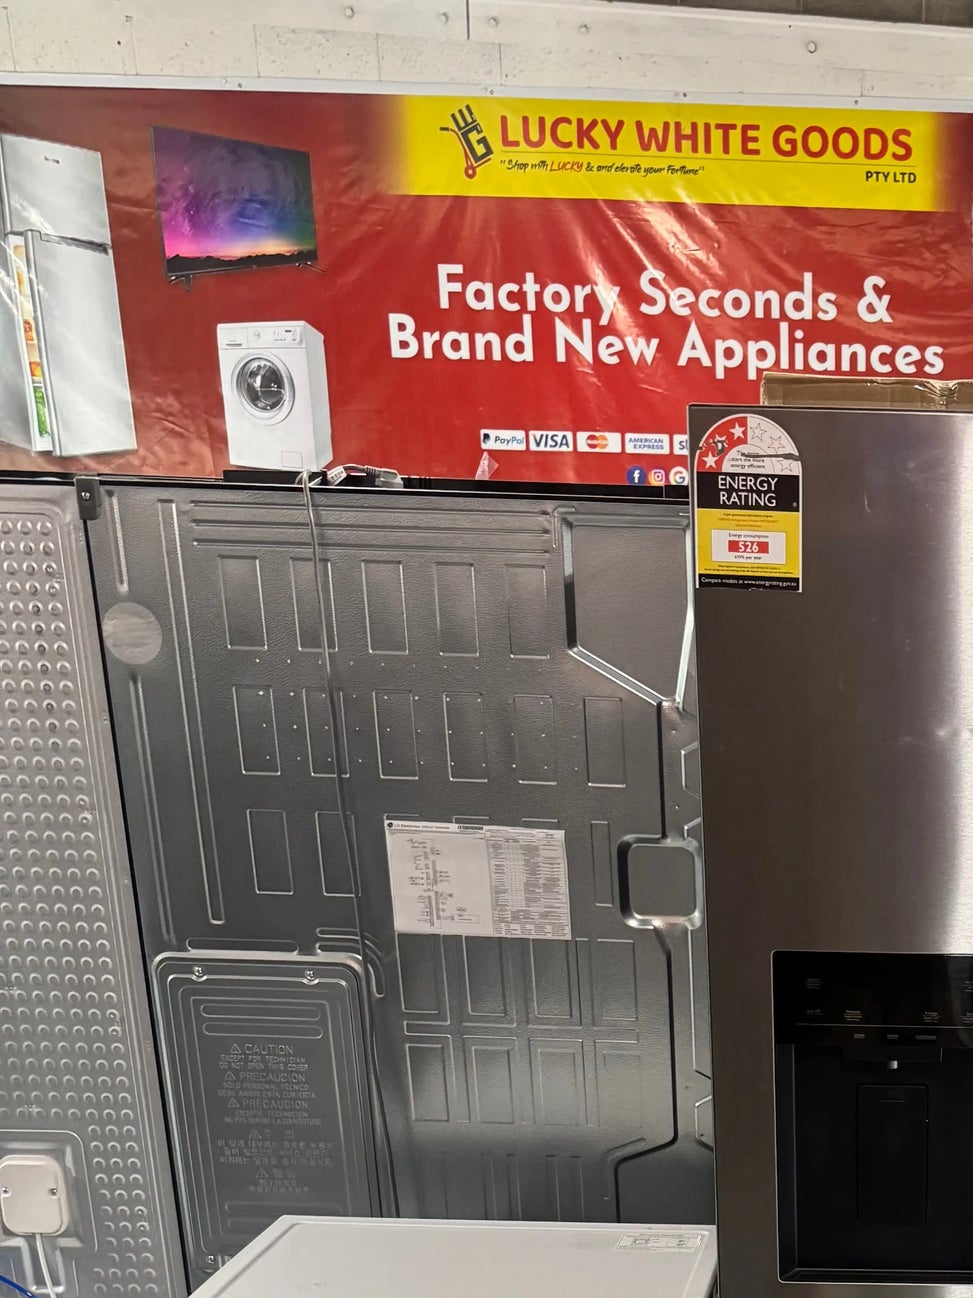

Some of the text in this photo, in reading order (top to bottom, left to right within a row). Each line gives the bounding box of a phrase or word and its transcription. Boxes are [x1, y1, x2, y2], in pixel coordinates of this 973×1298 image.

[500, 115, 913, 162] LUCKY WHITE GOODS
[549, 160, 584, 172] LUCKY
[597, 163, 614, 173] and
[614, 163, 642, 174] elevate
[643, 166, 665, 177] your
[864, 170, 917, 184] PTY LTD
[437, 263, 894, 326] Factory Seconds &
[388, 313, 944, 380] Brand New Appliances
[494, 435, 525, 446] PayPal
[532, 434, 570, 448] VISA
[718, 475, 778, 491] ENERGY
[719, 491, 776, 507] RATING
[738, 541, 759, 553] 526
[244, 1044, 294, 1055] CAUTION
[220, 1054, 245, 1062] EXCEPT
